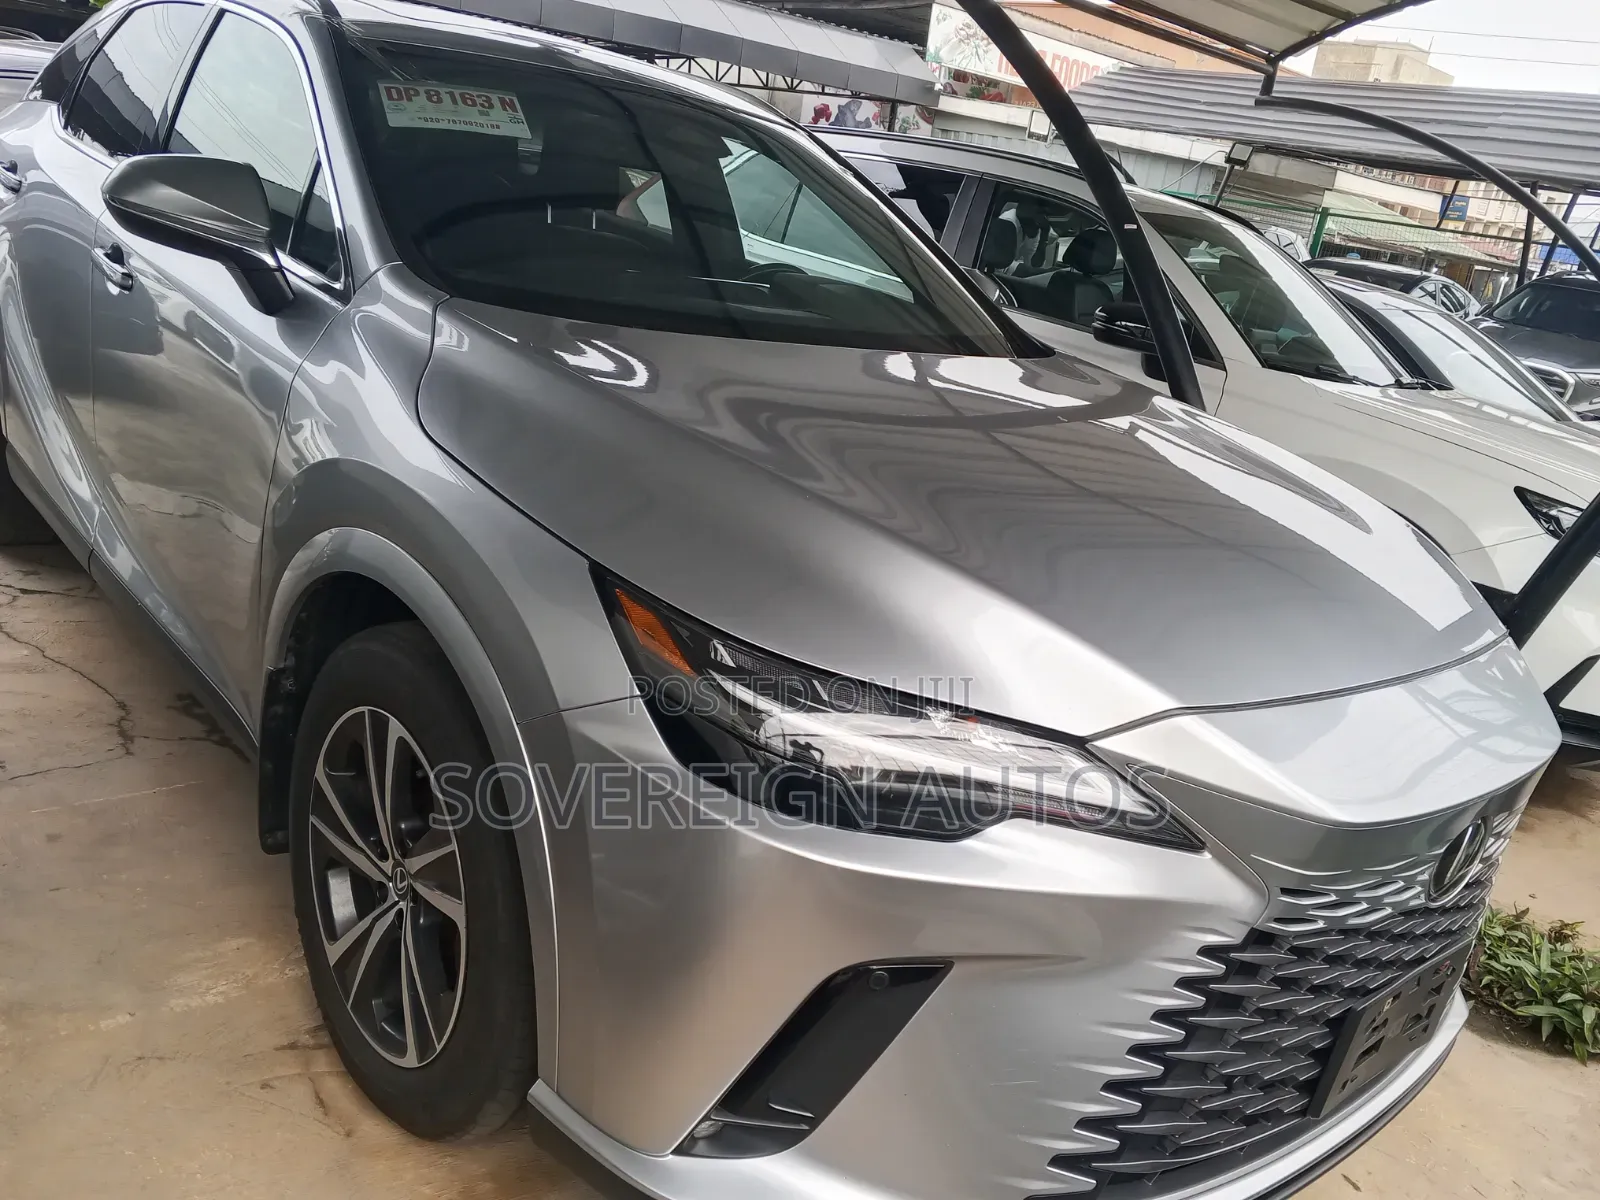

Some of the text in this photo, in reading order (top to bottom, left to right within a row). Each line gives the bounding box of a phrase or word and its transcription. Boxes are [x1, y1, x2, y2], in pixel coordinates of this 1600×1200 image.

[384, 85, 420, 103] DP
[424, 88, 495, 110] 8163
[498, 96, 519, 114] N
